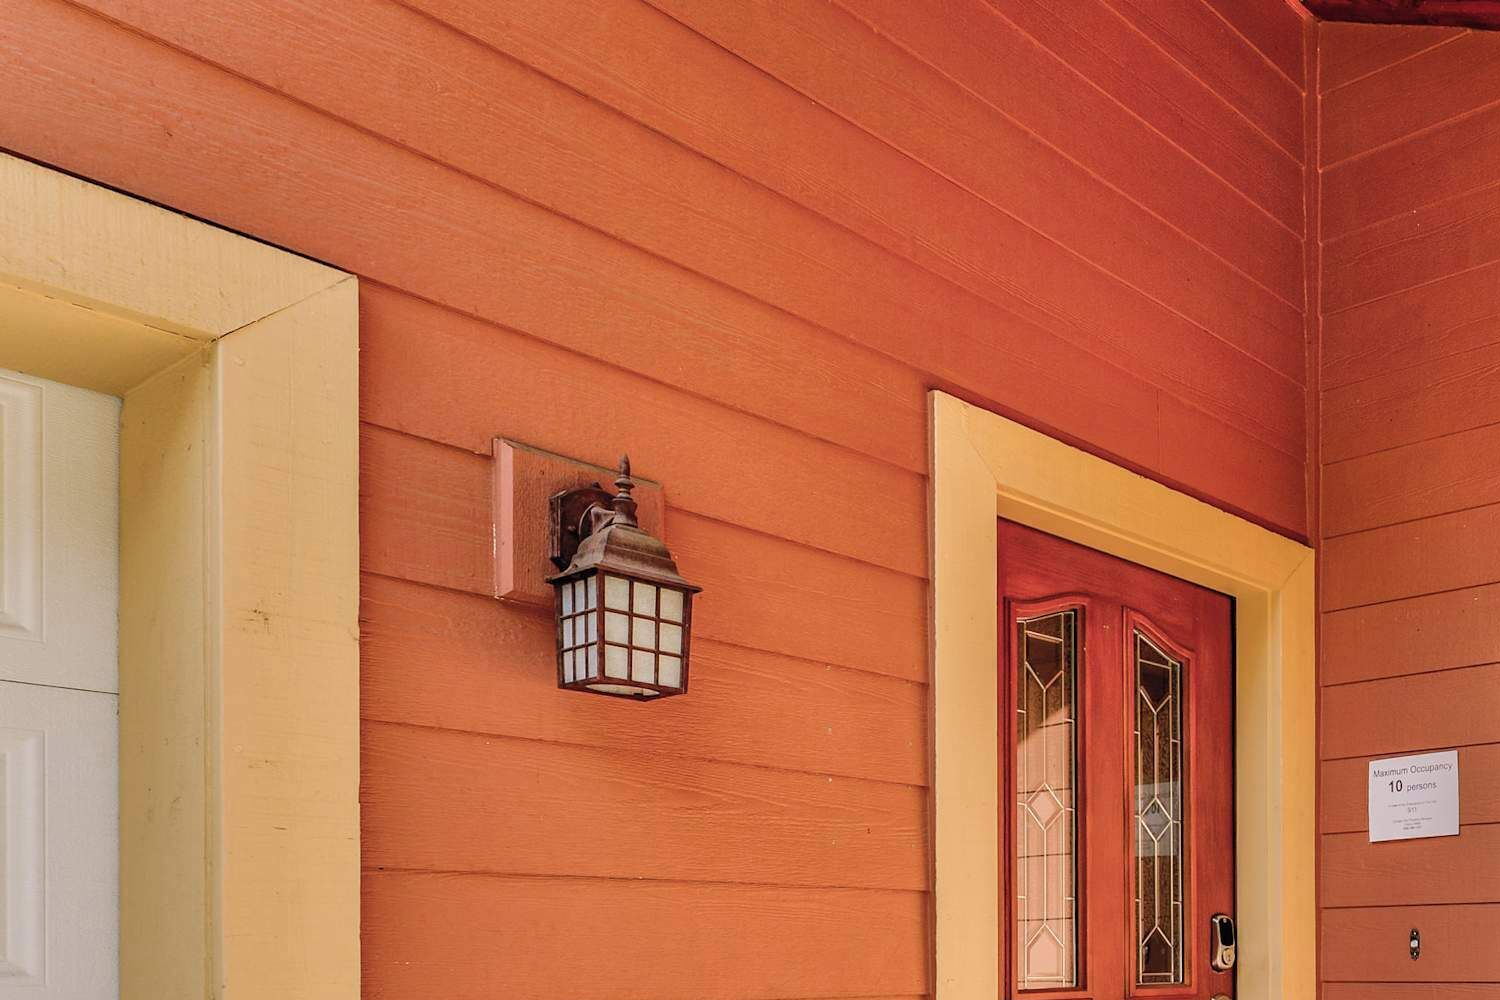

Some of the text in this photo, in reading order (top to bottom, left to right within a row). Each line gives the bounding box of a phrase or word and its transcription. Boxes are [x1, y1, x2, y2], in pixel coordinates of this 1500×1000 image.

[1373, 763, 1453, 778] Maximum Occupancy
[1388, 780, 1437, 793] 10 persons
